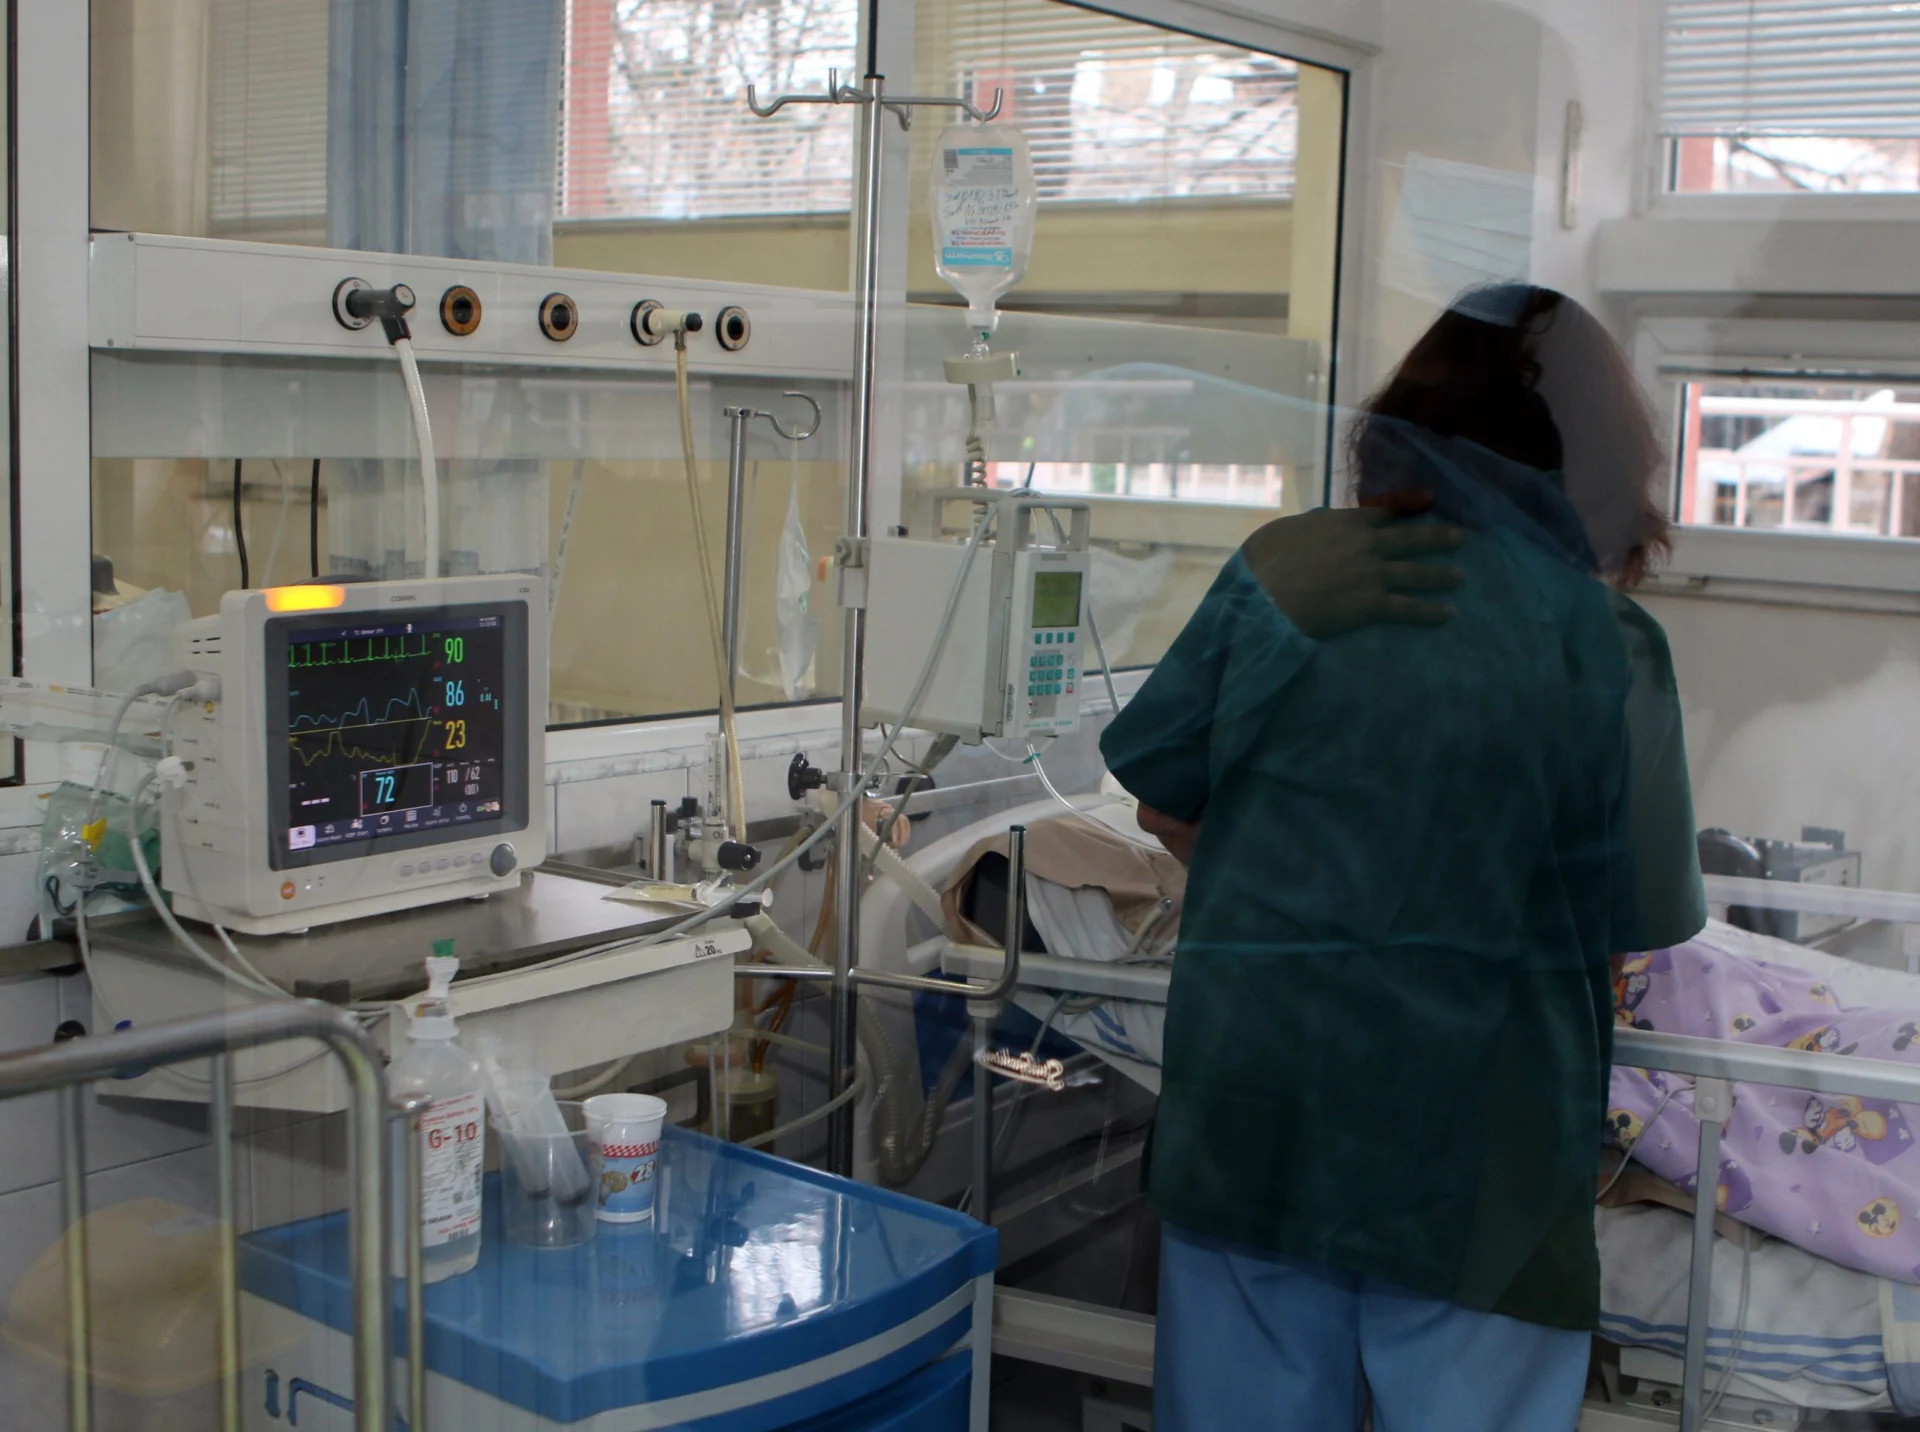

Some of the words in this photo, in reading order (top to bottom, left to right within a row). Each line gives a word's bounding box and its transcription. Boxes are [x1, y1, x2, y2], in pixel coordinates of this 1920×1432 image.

[445, 637, 463, 664] 90
[446, 680, 464, 706] 86
[445, 720, 466, 750] 23
[375, 776, 395, 804] 72
[704, 945, 716, 955] 20
[428, 1122, 477, 1150] G-10
[632, 1160, 656, 1184] 28
